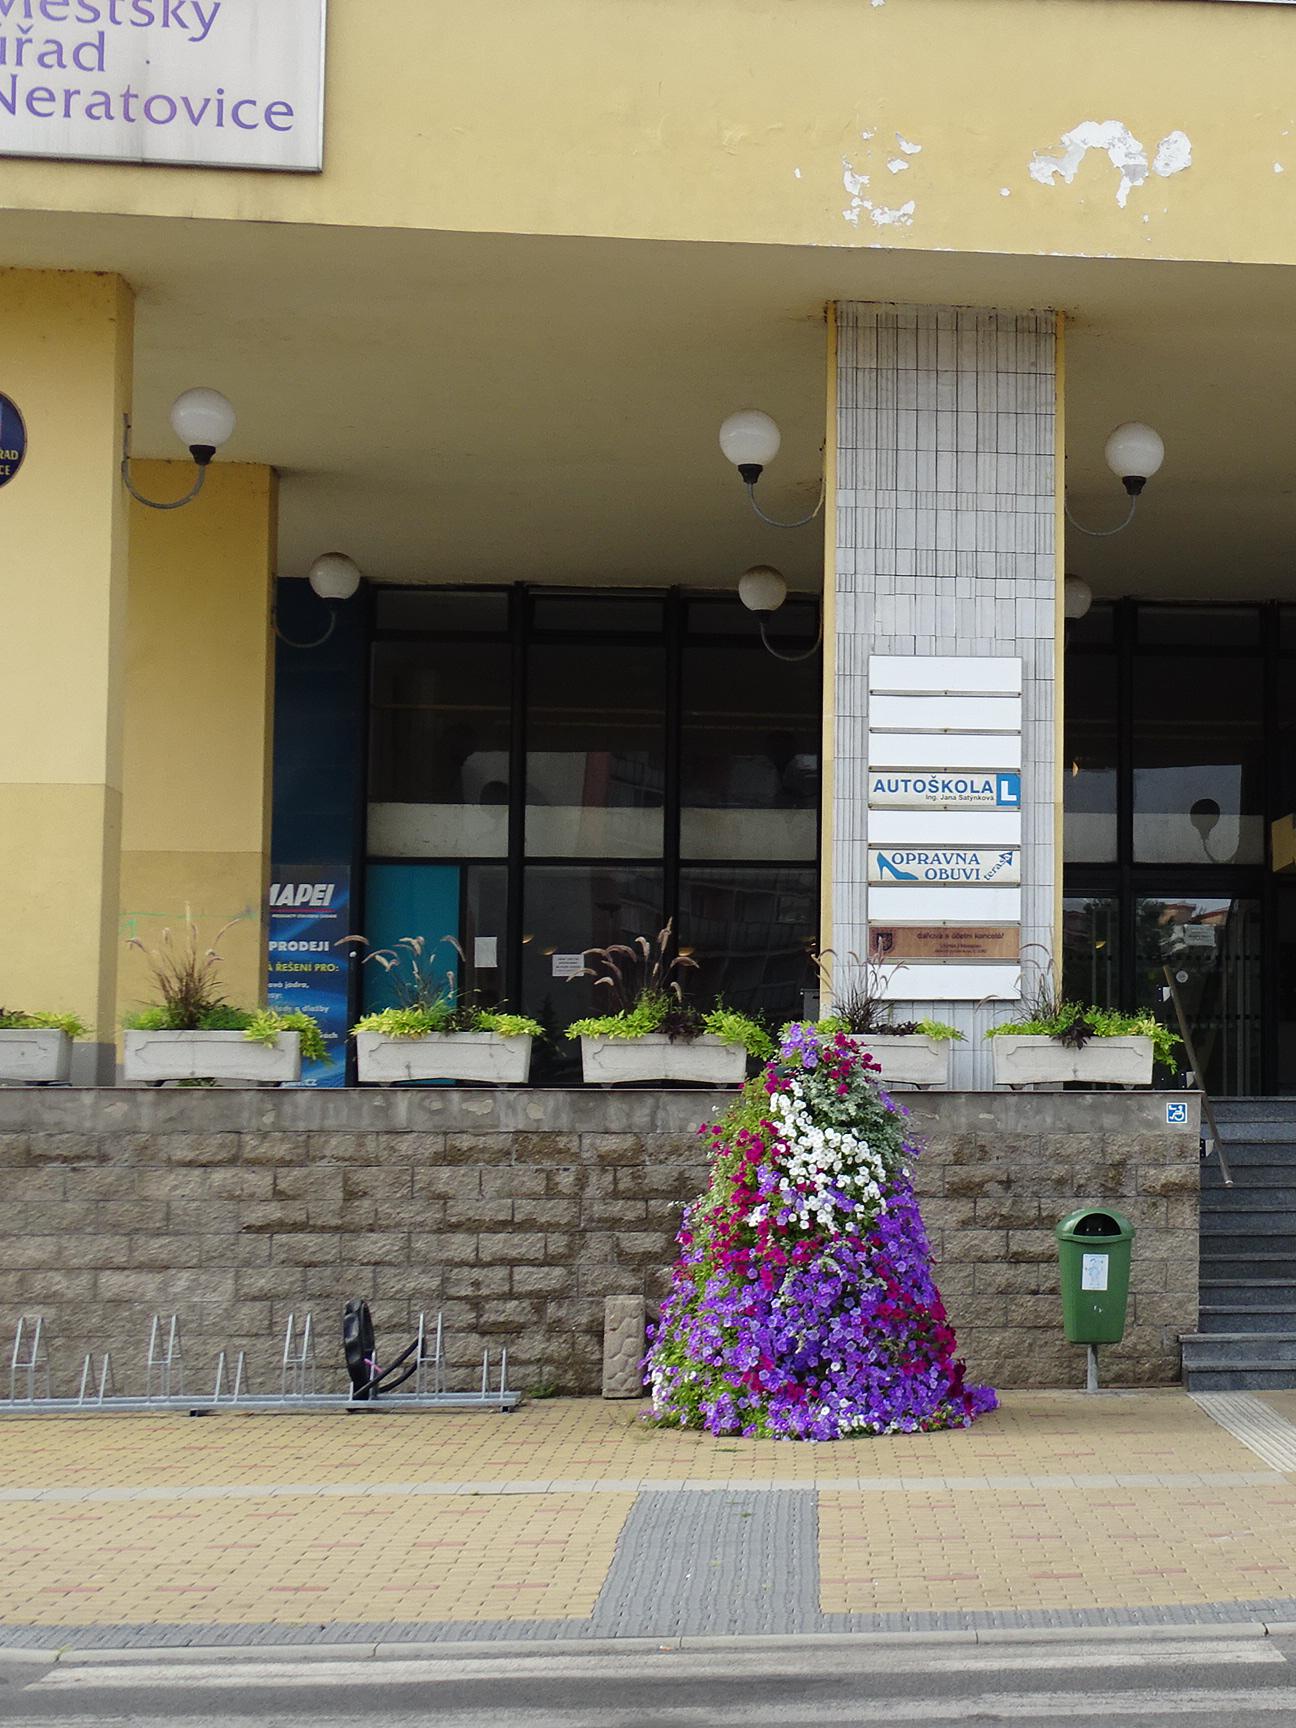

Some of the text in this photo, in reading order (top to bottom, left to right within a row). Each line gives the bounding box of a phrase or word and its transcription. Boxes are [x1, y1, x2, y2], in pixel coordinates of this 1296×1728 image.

[873, 775, 994, 793] AUTOŠKOLA
[891, 852, 980, 865] OPRAVNA
[925, 868, 981, 880] OBUVI
[268, 941, 330, 951] PRODEJI
